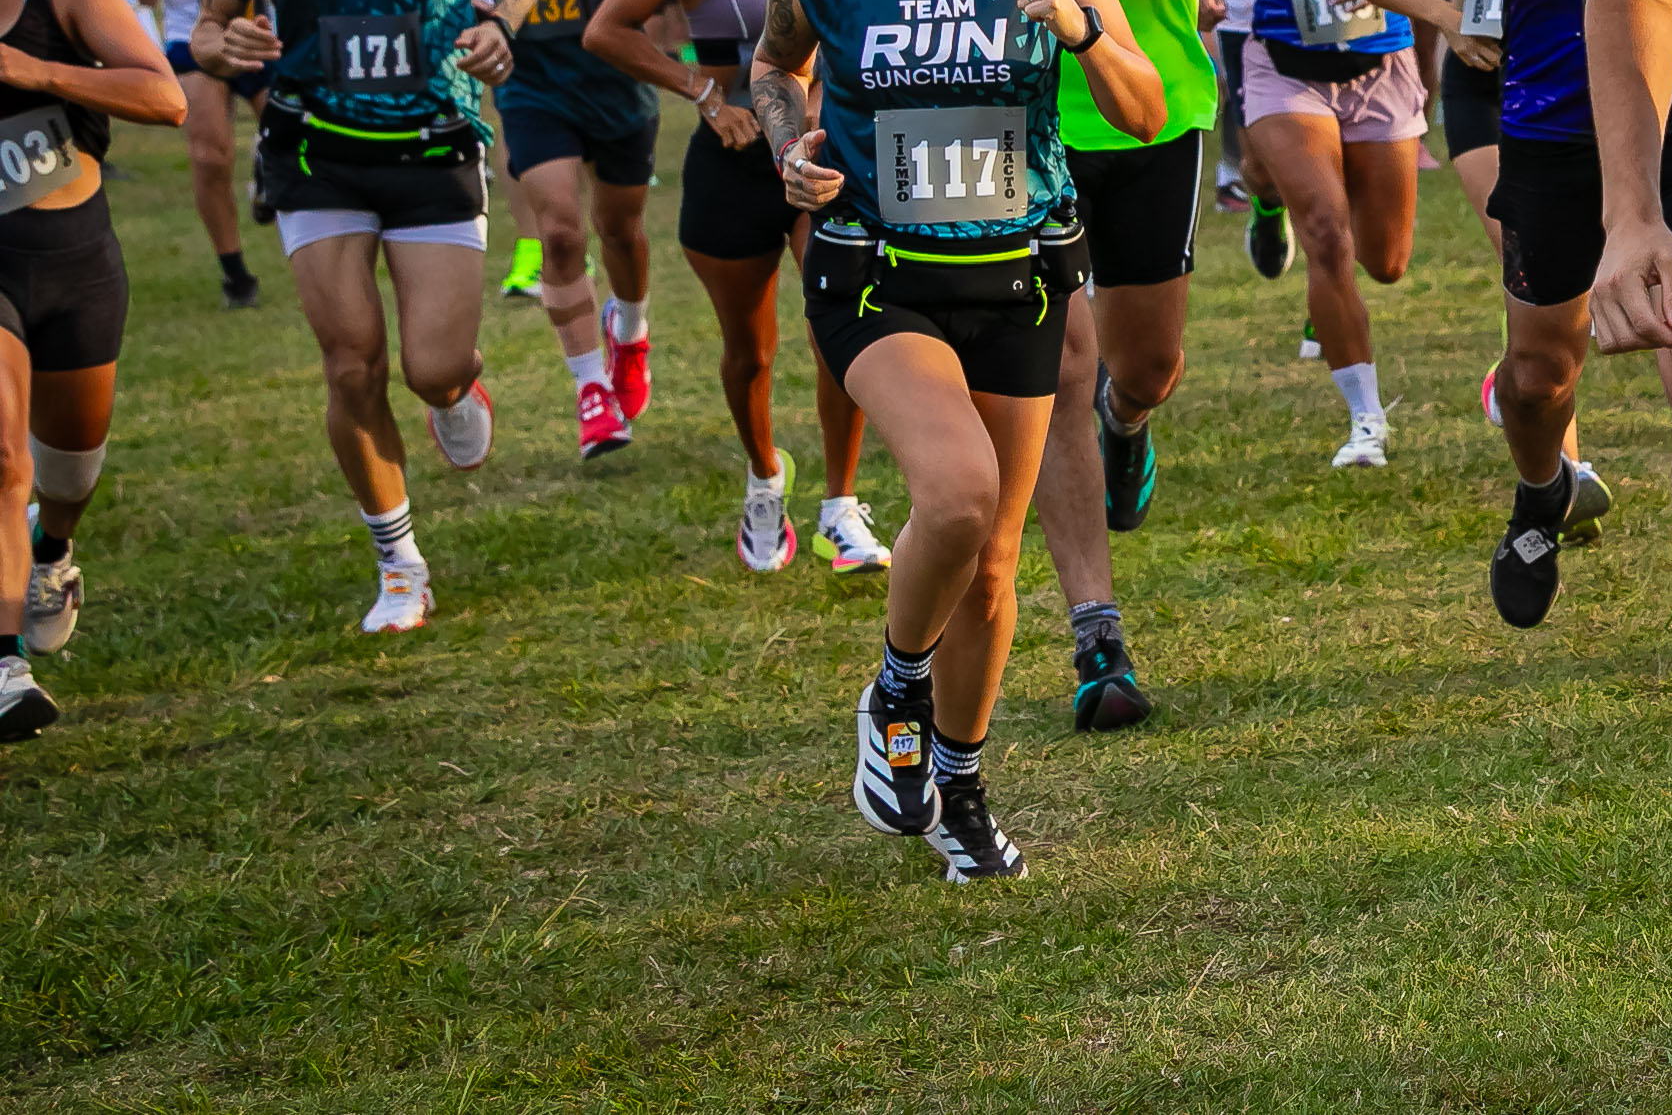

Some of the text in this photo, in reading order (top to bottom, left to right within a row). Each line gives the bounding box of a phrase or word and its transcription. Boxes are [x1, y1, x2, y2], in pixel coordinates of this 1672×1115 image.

[346, 33, 411, 79] 171
[861, 18, 1008, 69] RUN
[861, 64, 1011, 90] SUNCHALES
[0, 130, 58, 190] 03
[892, 133, 910, 203] TIEMPO
[911, 138, 999, 199] 117
[1003, 130, 1016, 199] EXACTO
